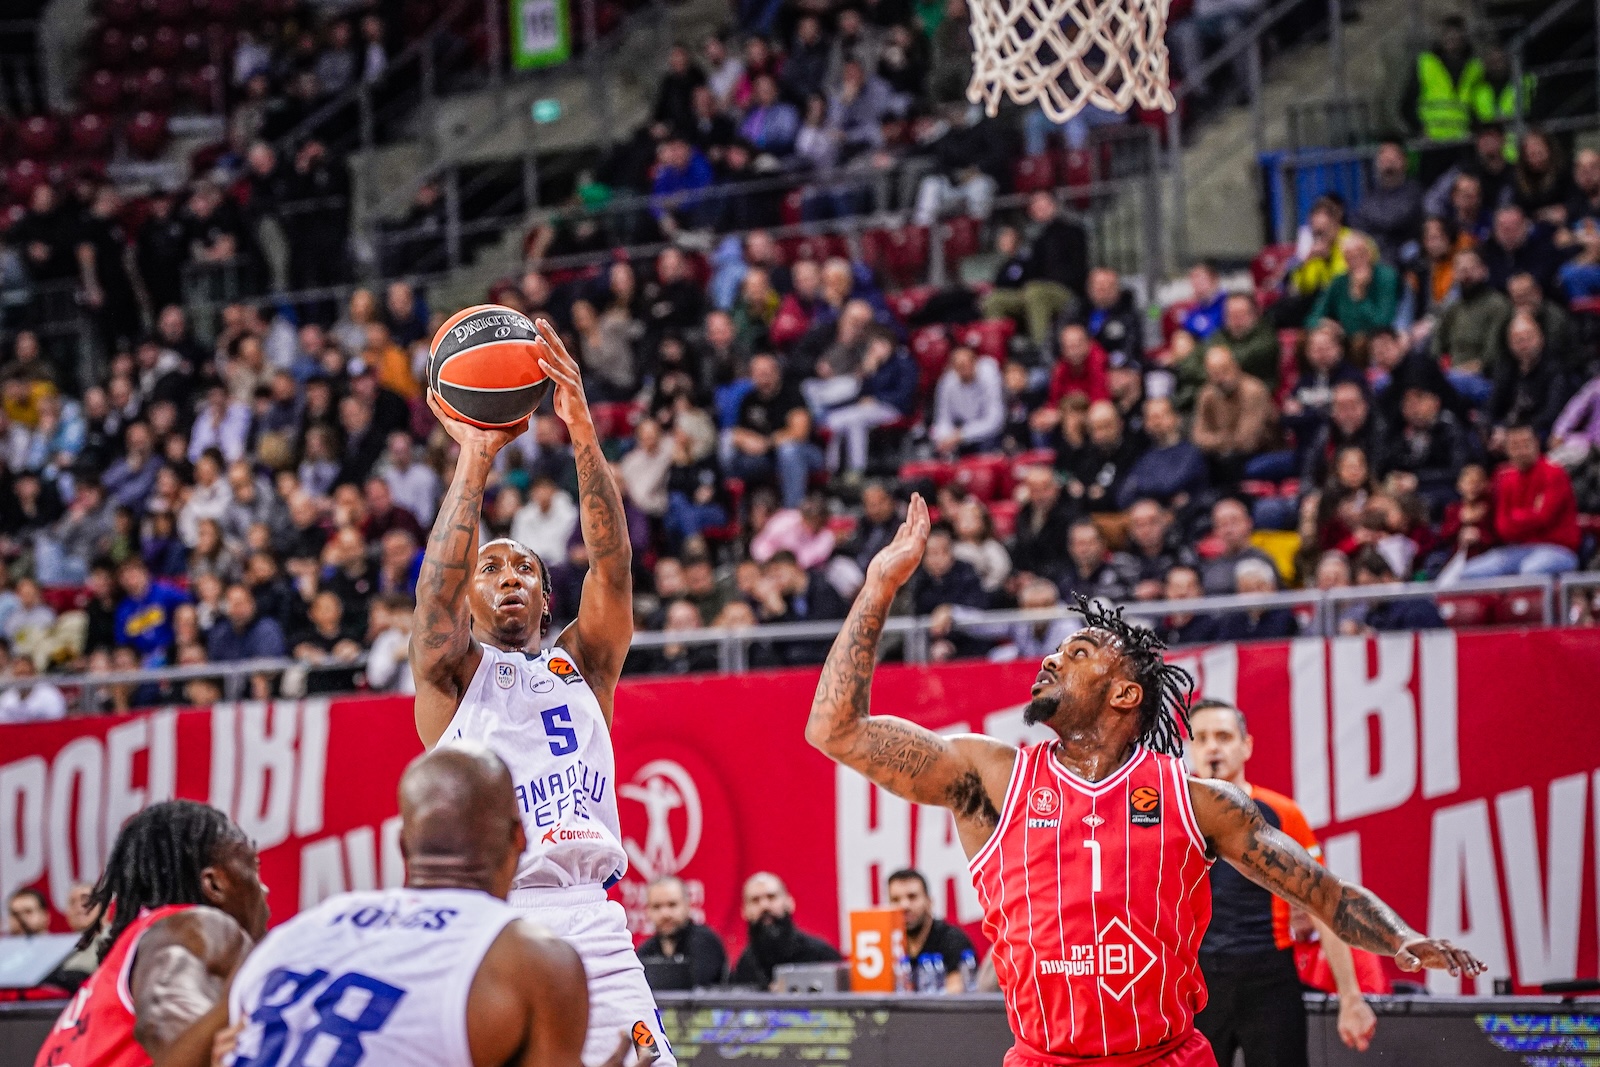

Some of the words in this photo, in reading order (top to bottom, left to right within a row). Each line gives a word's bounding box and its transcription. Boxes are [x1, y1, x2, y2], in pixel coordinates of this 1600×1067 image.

[499, 665, 512, 676] 50
[540, 704, 579, 757] 5
[1290, 630, 1460, 828] IBI
[209, 701, 331, 851] IBI
[560, 829, 603, 840] corendon
[1028, 818, 1058, 828] RTMI
[1082, 840, 1102, 892] 1
[1425, 770, 1600, 995] AV
[856, 930, 885, 979] 5
[1040, 960, 1095, 976] השקעות
[1071, 944, 1095, 960] בית
[1099, 944, 1134, 975] IBI
[232, 967, 407, 1067] 38
